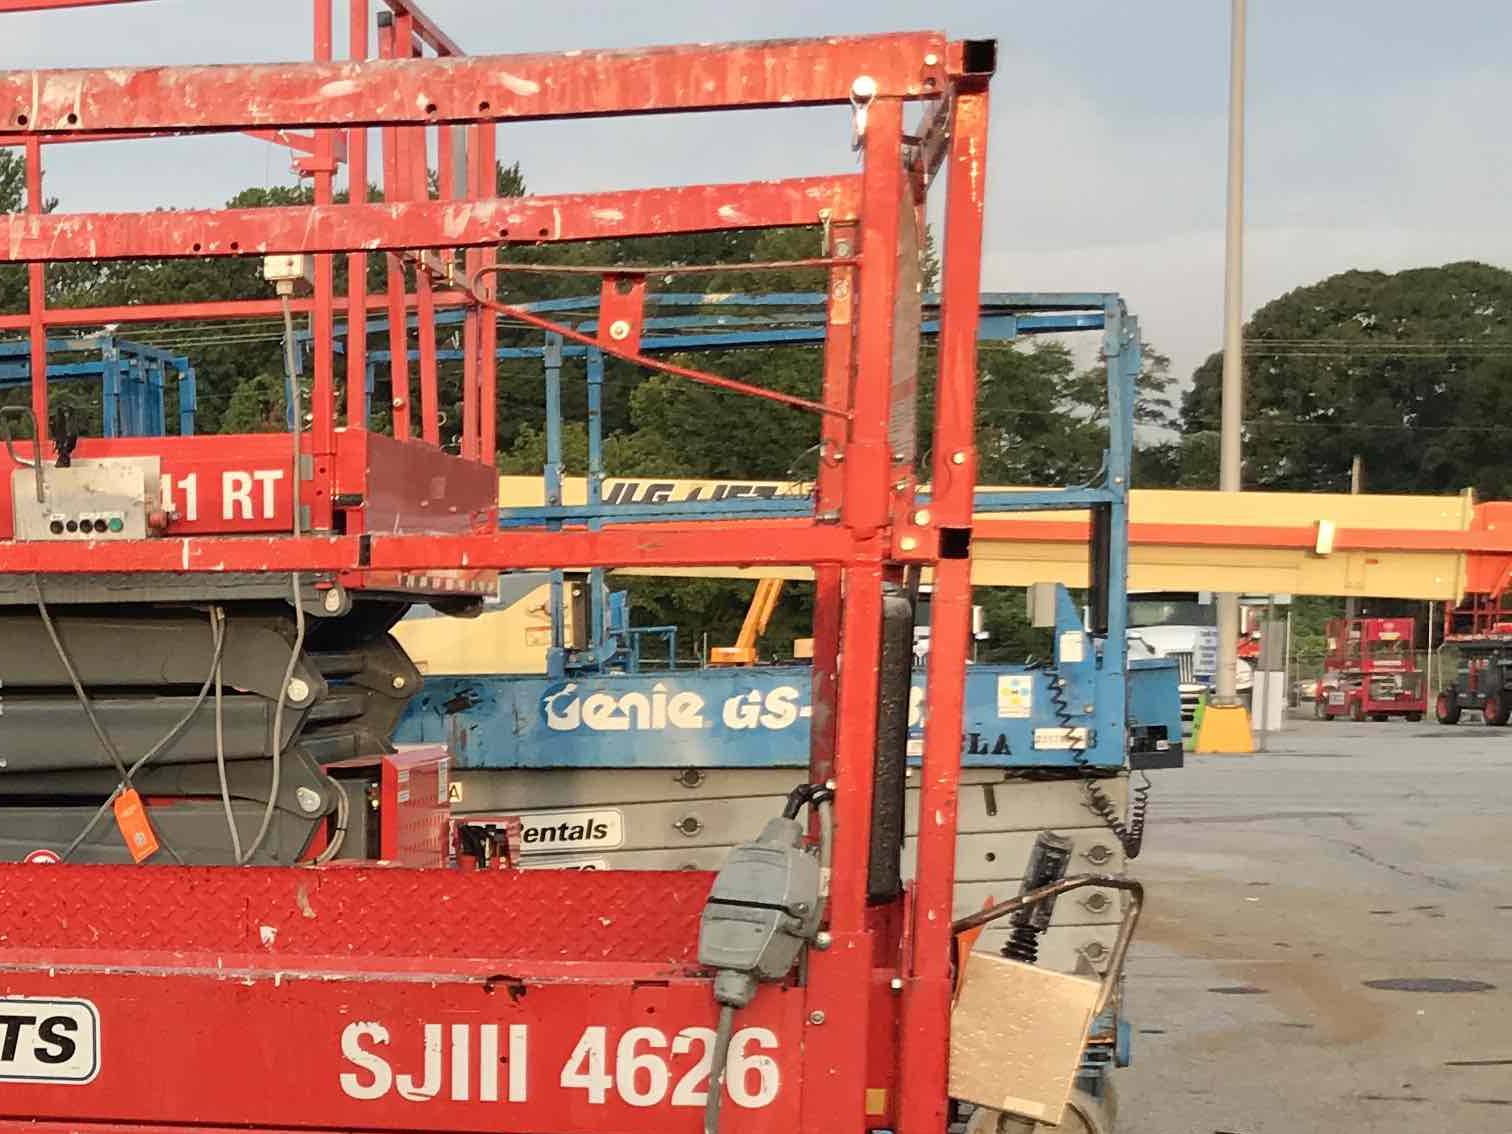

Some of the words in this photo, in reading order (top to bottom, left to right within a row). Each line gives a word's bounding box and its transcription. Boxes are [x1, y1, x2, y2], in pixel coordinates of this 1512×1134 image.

[222, 469, 284, 521] RT
[542, 681, 705, 731] Genie
[520, 818, 609, 845] entals
[560, 1025, 781, 1109] 4626
